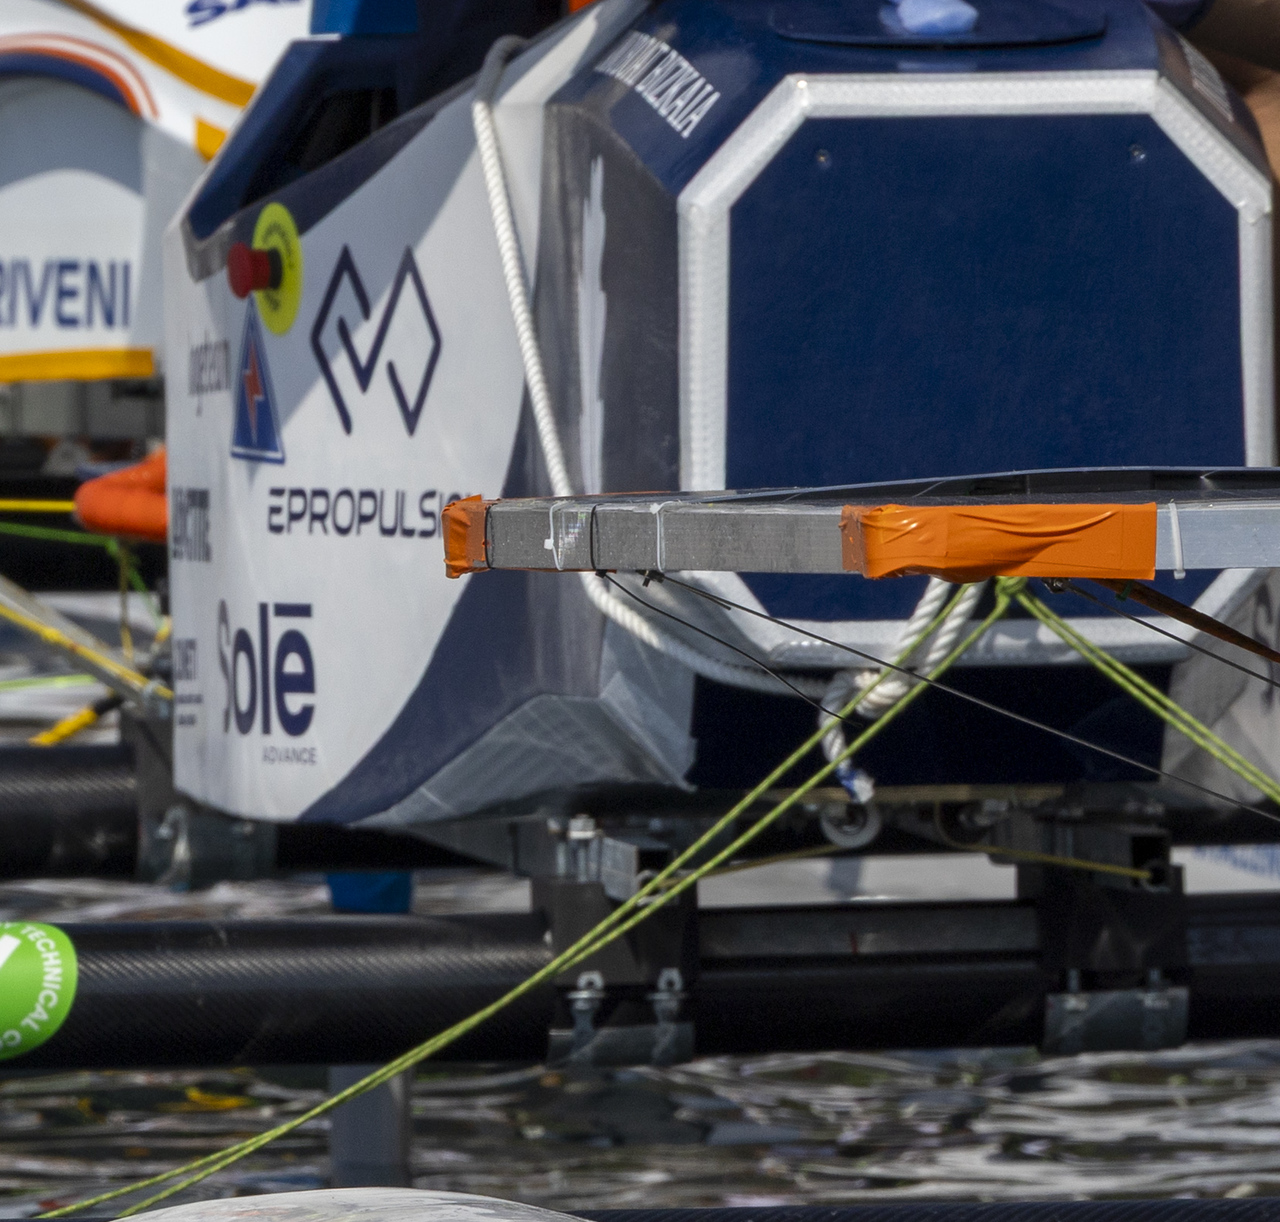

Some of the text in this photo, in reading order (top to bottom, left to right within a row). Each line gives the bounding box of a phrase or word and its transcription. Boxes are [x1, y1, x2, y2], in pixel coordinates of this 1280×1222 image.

[635, 49, 721, 139] BIZKAIA
[268, 487, 471, 539] EPROPULSI
[262, 748, 317, 765] ADVANCE
[20, 923, 63, 1031] TECHNICAL
